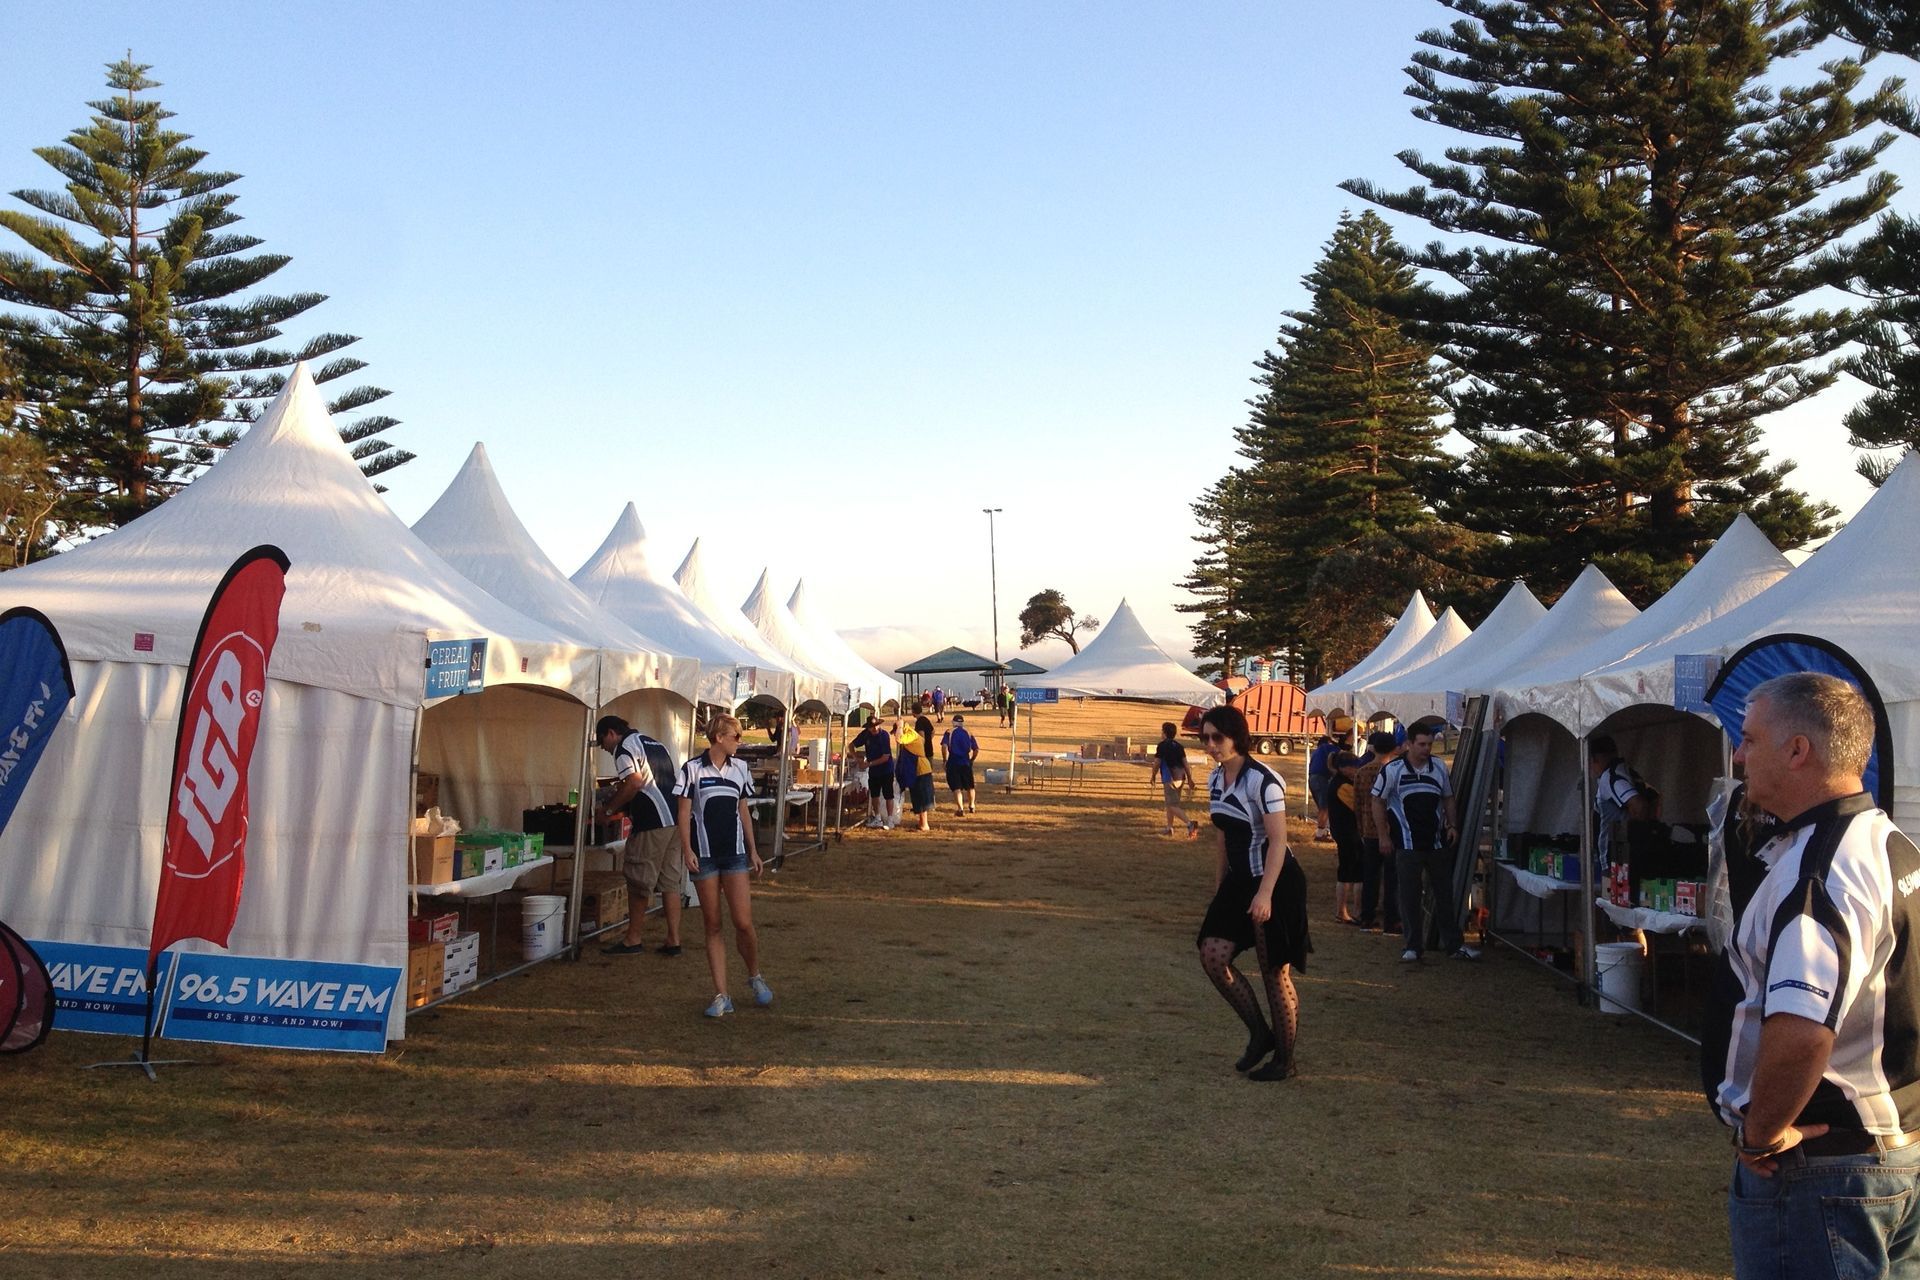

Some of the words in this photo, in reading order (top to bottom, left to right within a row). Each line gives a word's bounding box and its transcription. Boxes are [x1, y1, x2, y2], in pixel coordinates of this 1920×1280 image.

[431, 646, 468, 666] CEREAL
[471, 651, 481, 673] $1
[438, 669, 467, 689] FRUIT
[1018, 691, 1044, 700] JUICE
[177, 649, 247, 863] IGA
[112, 967, 164, 997] FM
[178, 973, 251, 1005] 96.5
[256, 977, 342, 1011] WAVE
[339, 983, 392, 1014] FM
[85, 1002, 116, 1011] NOW!
[206, 1012, 236, 1022] 80'S,
[281, 1017, 306, 1026] AND
[312, 1019, 344, 1028] NOW!
